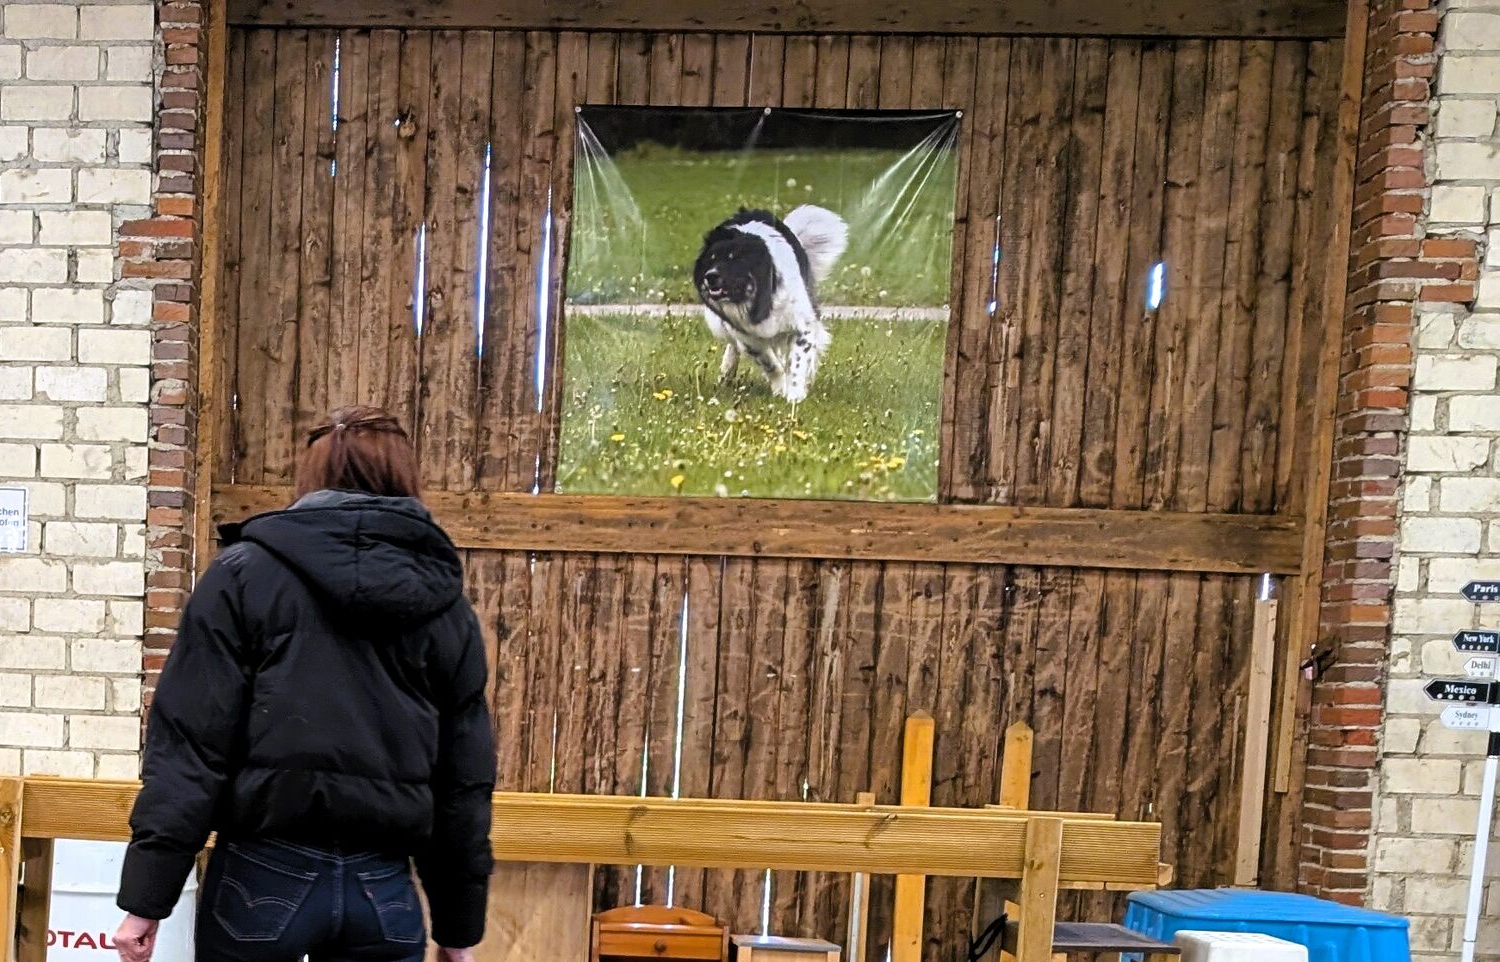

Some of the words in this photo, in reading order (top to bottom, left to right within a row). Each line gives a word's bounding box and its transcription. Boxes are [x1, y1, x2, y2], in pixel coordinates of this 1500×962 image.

[1473, 584, 1499, 593] Paris
[1463, 634, 1478, 642] New
[1471, 661, 1491, 669] Delhi
[1444, 684, 1477, 695] Mexico
[1455, 711, 1478, 721] Sydney
[46, 930, 117, 950] OTAL
